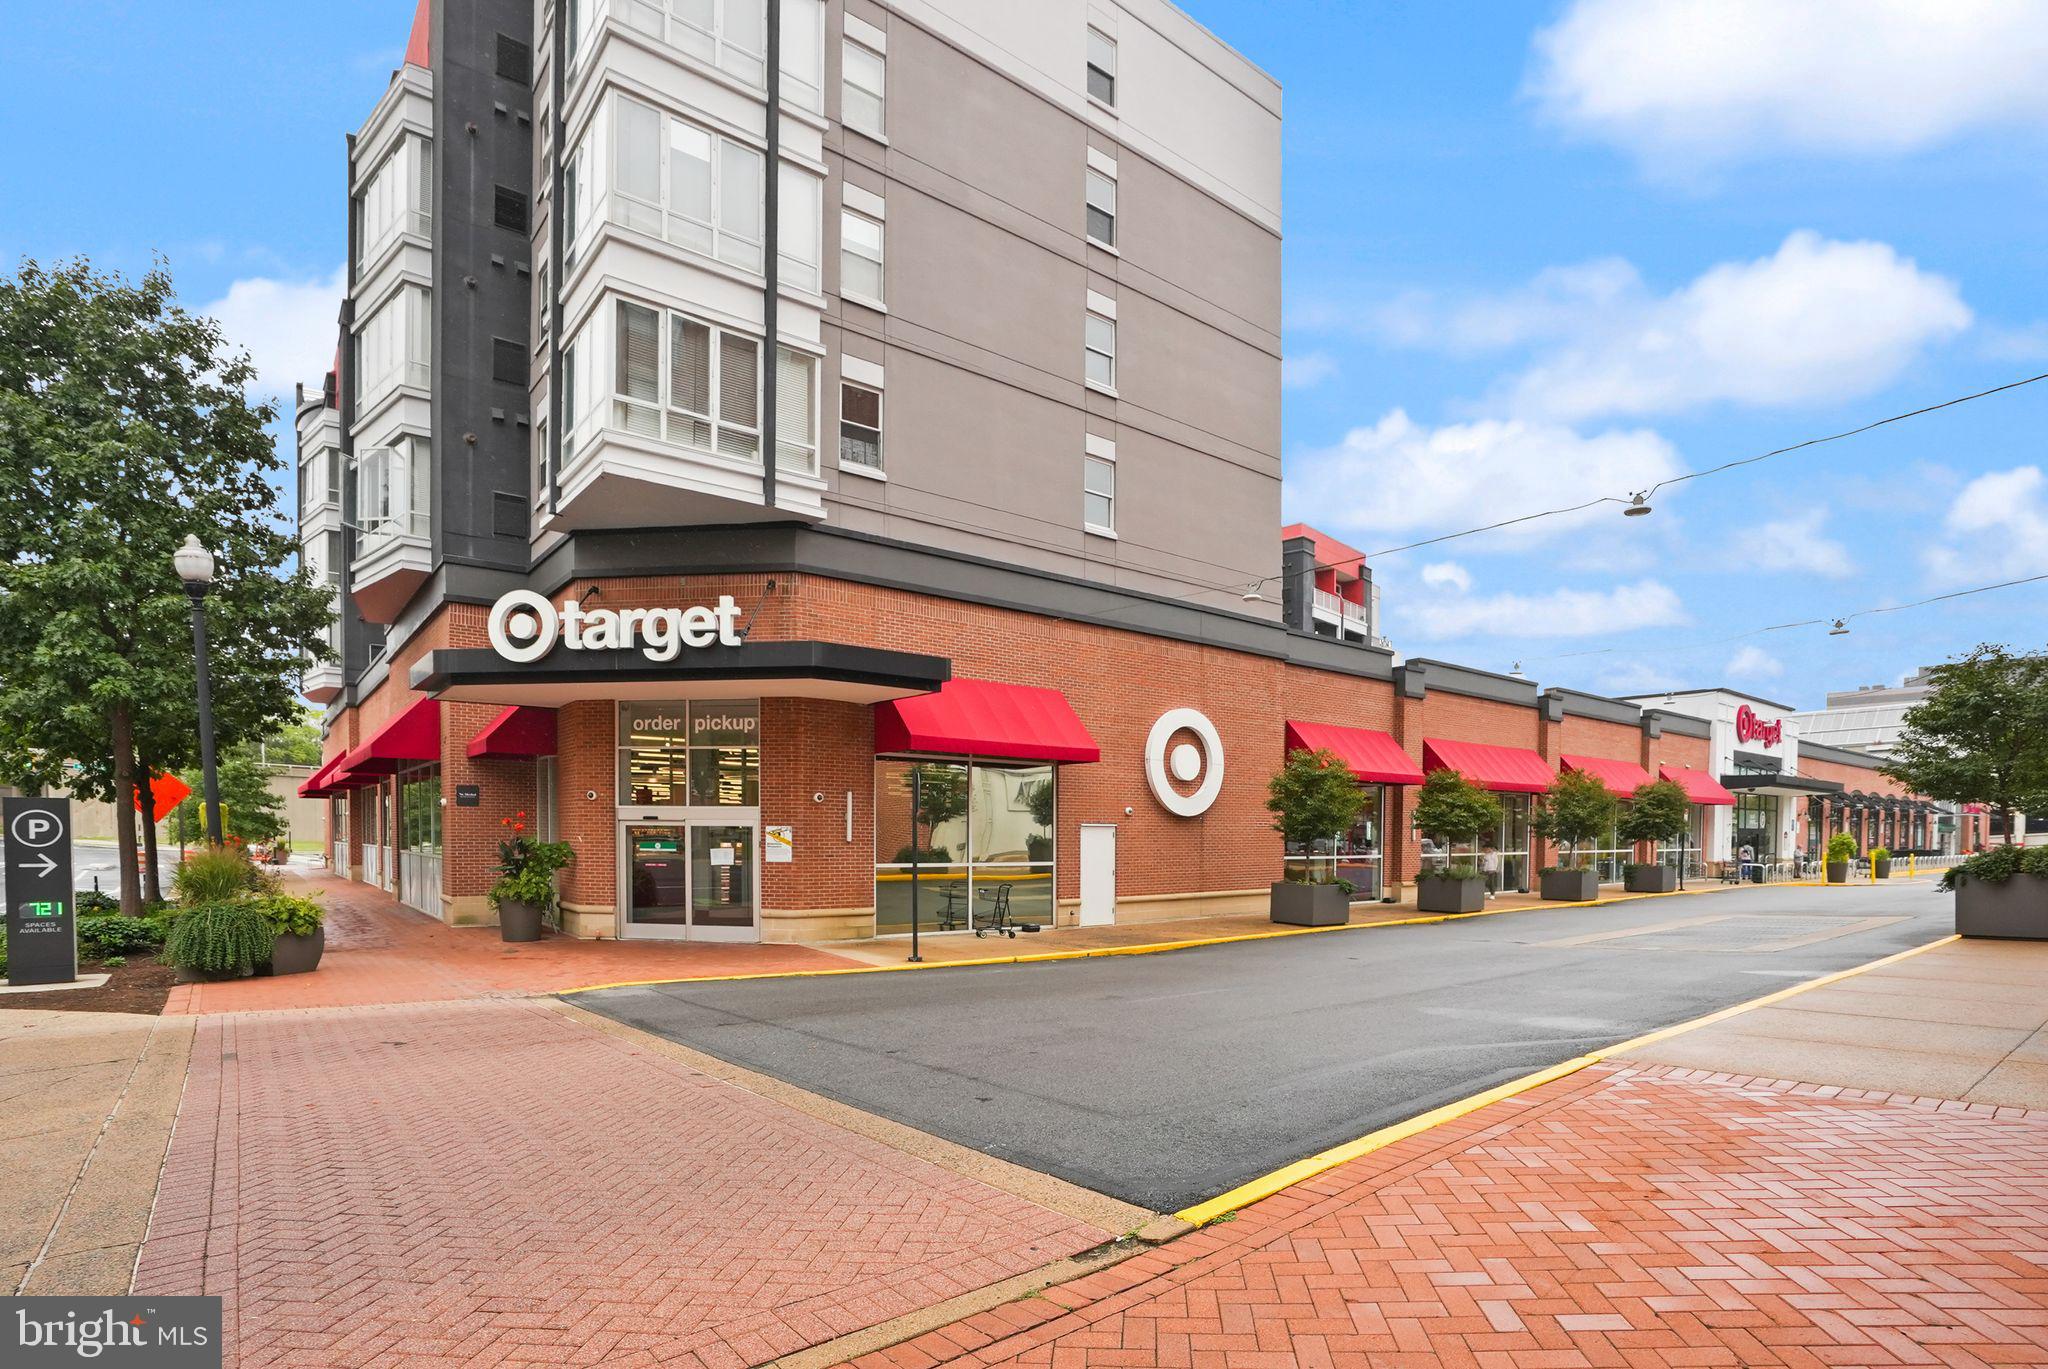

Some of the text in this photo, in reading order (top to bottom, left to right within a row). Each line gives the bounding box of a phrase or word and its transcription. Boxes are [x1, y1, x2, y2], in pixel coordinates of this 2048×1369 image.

[559, 595, 742, 662] target
[633, 715, 756, 733] order pickup
[1750, 713, 1782, 749] target
[28, 819, 50, 839] P
[19, 926, 62, 934] AVAILABLE
